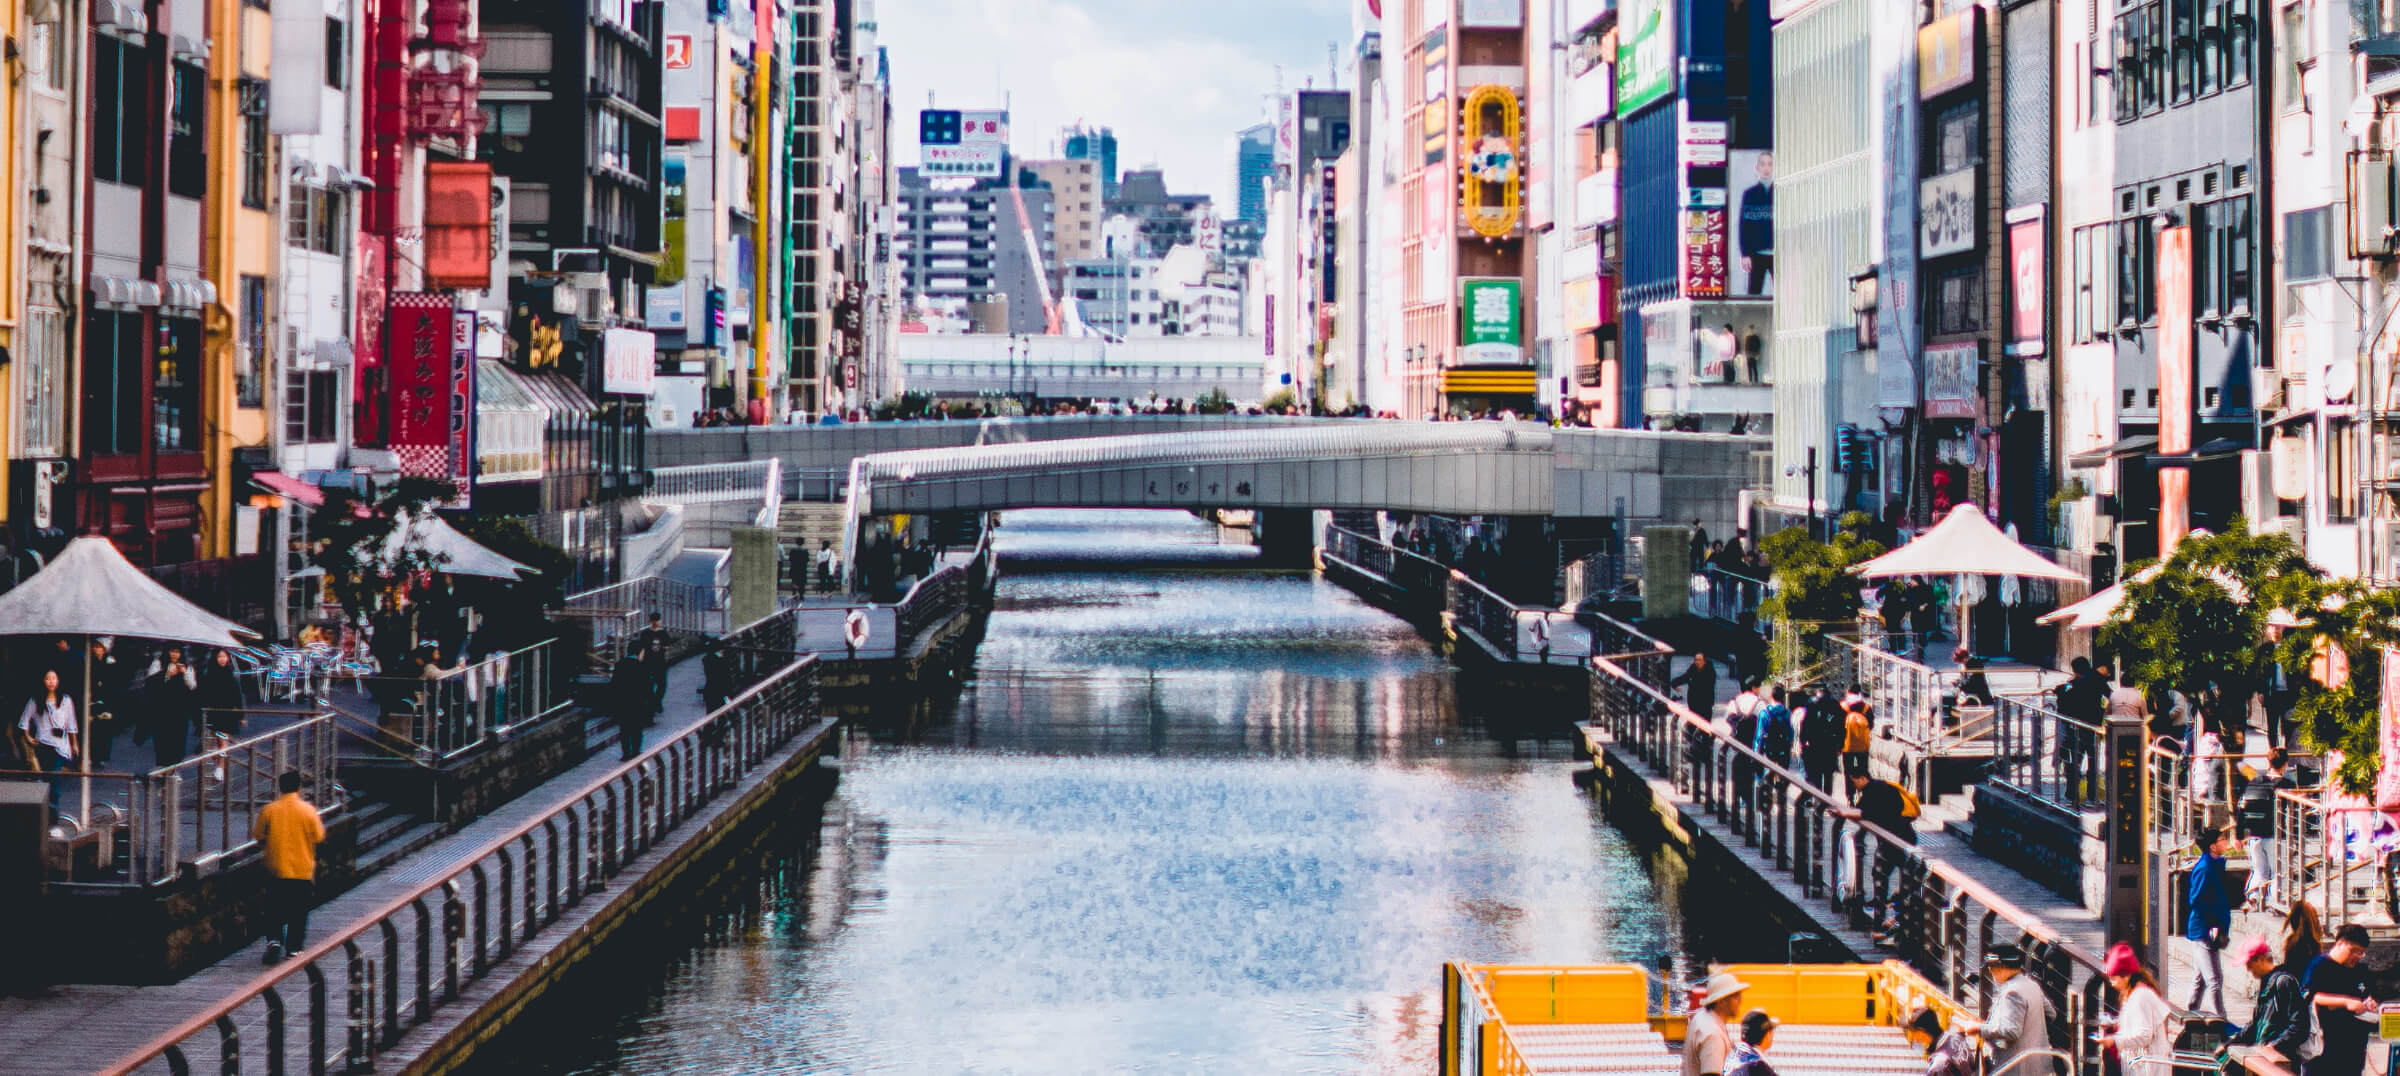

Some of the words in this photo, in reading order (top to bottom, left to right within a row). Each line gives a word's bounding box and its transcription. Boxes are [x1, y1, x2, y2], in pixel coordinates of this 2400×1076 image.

[1200, 214, 1216, 249] かに
[1708, 210, 1724, 289] インターネット
[1690, 244, 1706, 288] コミック
[1148, 480, 1251, 497] えびす橋
